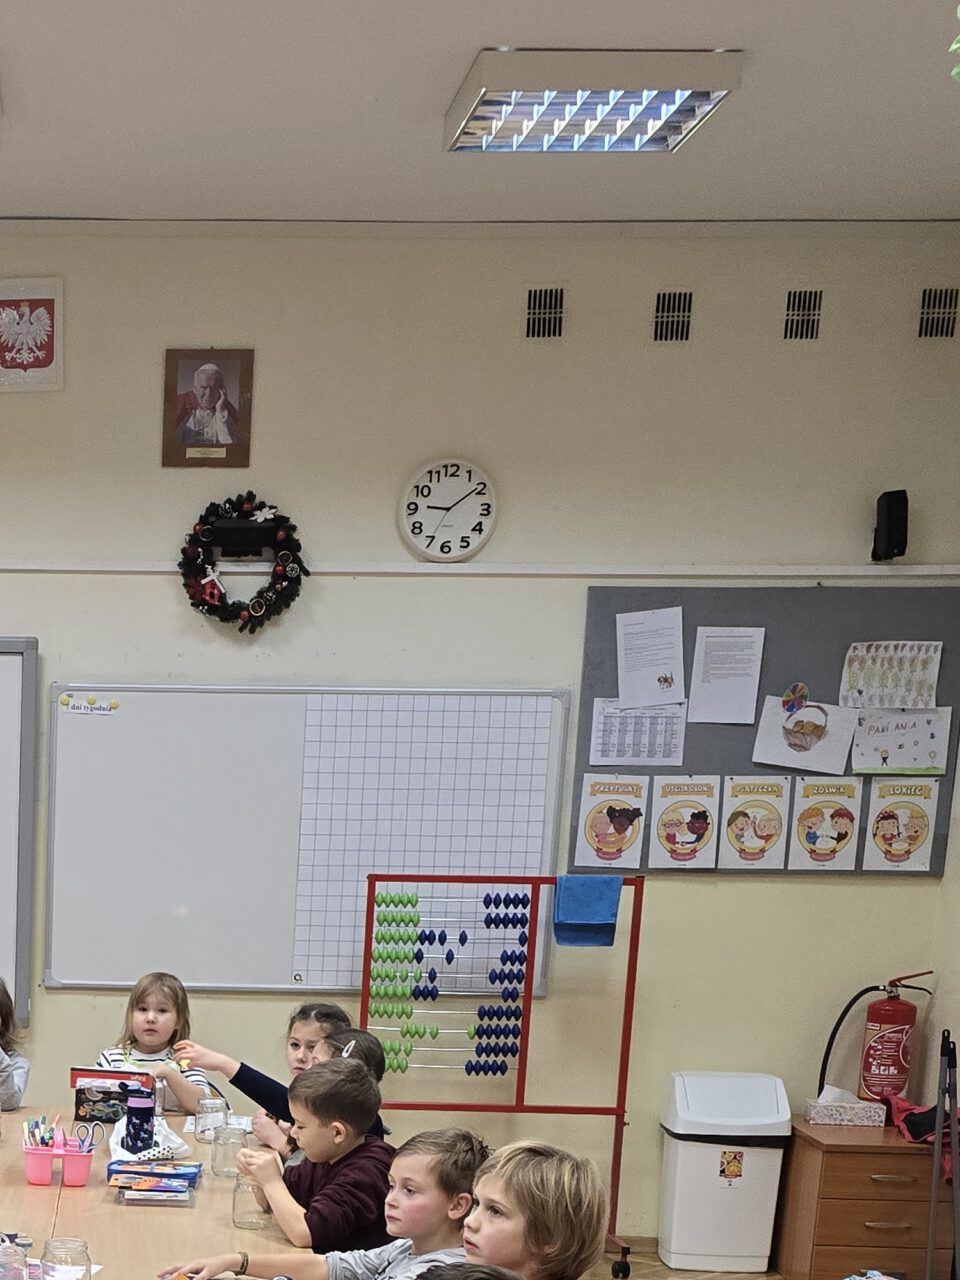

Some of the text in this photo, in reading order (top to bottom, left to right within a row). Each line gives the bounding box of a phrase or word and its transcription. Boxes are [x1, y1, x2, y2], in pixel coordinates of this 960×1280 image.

[427, 470, 441, 483] 11
[442, 464, 460, 478] 12
[466, 470, 472, 482] 1
[414, 485, 431, 498] 10
[475, 482, 487, 495] 2
[407, 502, 419, 516] 9
[480, 503, 491, 516] 3
[411, 521, 423, 535] 8
[471, 521, 483, 535] 4
[425, 535, 435, 549] 7
[440, 540, 451, 554] 6
[460, 536, 471, 549] 5
